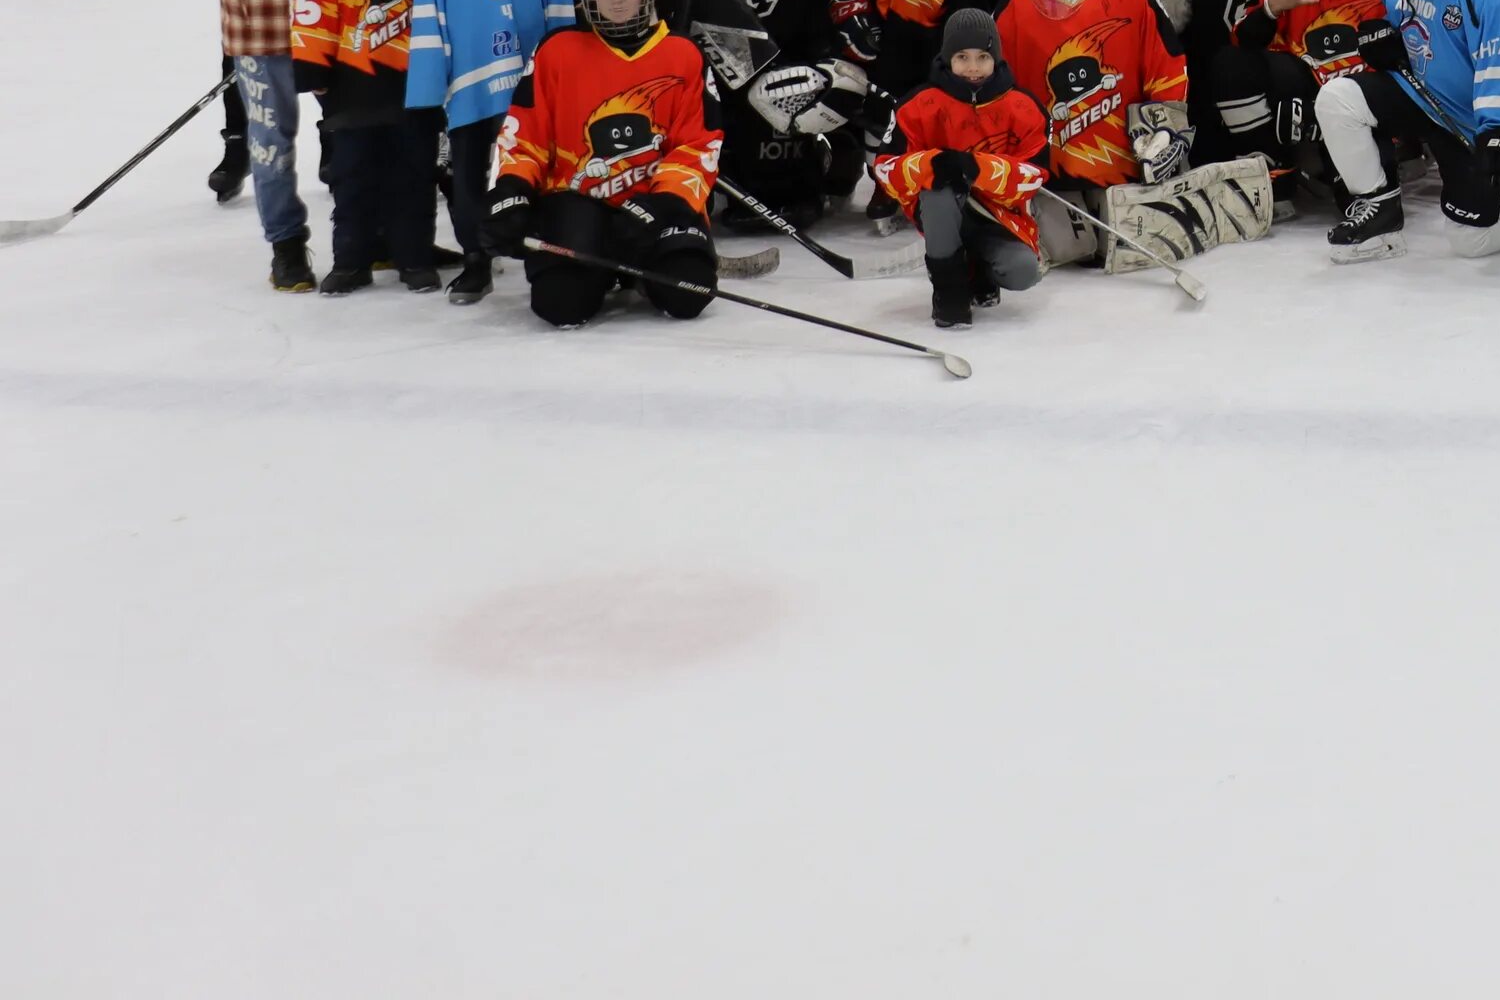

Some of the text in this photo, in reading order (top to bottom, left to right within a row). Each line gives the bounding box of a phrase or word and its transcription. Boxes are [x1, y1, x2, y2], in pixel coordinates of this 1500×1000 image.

[1058, 91, 1122, 145] МЕТЕОР
[743, 194, 797, 236] BAUER
[1445, 201, 1481, 222] CCM
